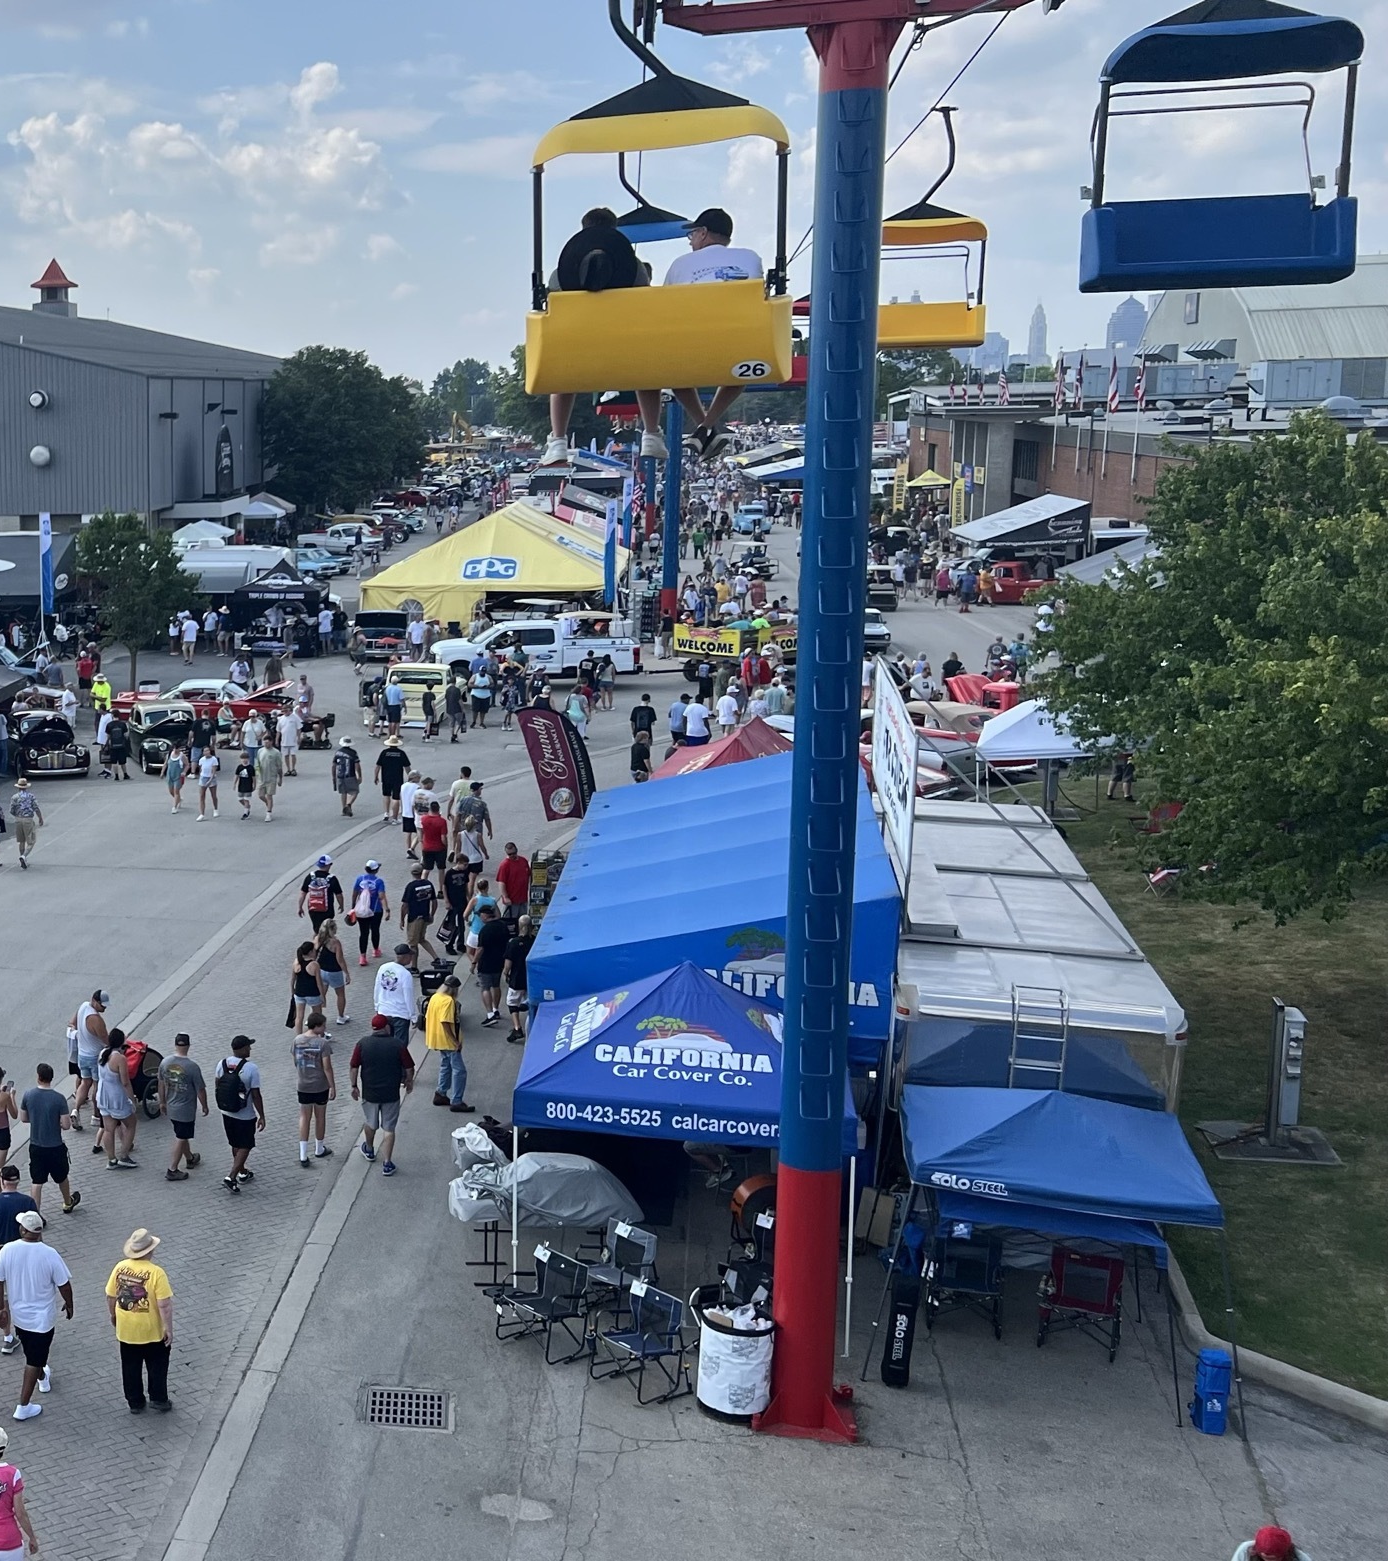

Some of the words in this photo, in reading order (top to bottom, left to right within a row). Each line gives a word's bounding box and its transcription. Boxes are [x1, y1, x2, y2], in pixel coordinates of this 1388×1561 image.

[738, 363, 765, 376] 26
[465, 559, 514, 578] PPG
[677, 638, 734, 654] WELCOME
[527, 714, 569, 780] Grundy
[595, 1043, 773, 1073] CALIFORNIA
[612, 1064, 648, 1079] Car
[653, 1066, 713, 1083] Cover
[718, 1071, 753, 1087] Co.
[546, 1101, 662, 1127] 800-423-5525
[972, 1180, 1008, 1196] STEEL
[892, 1338, 904, 1361] STEEL
